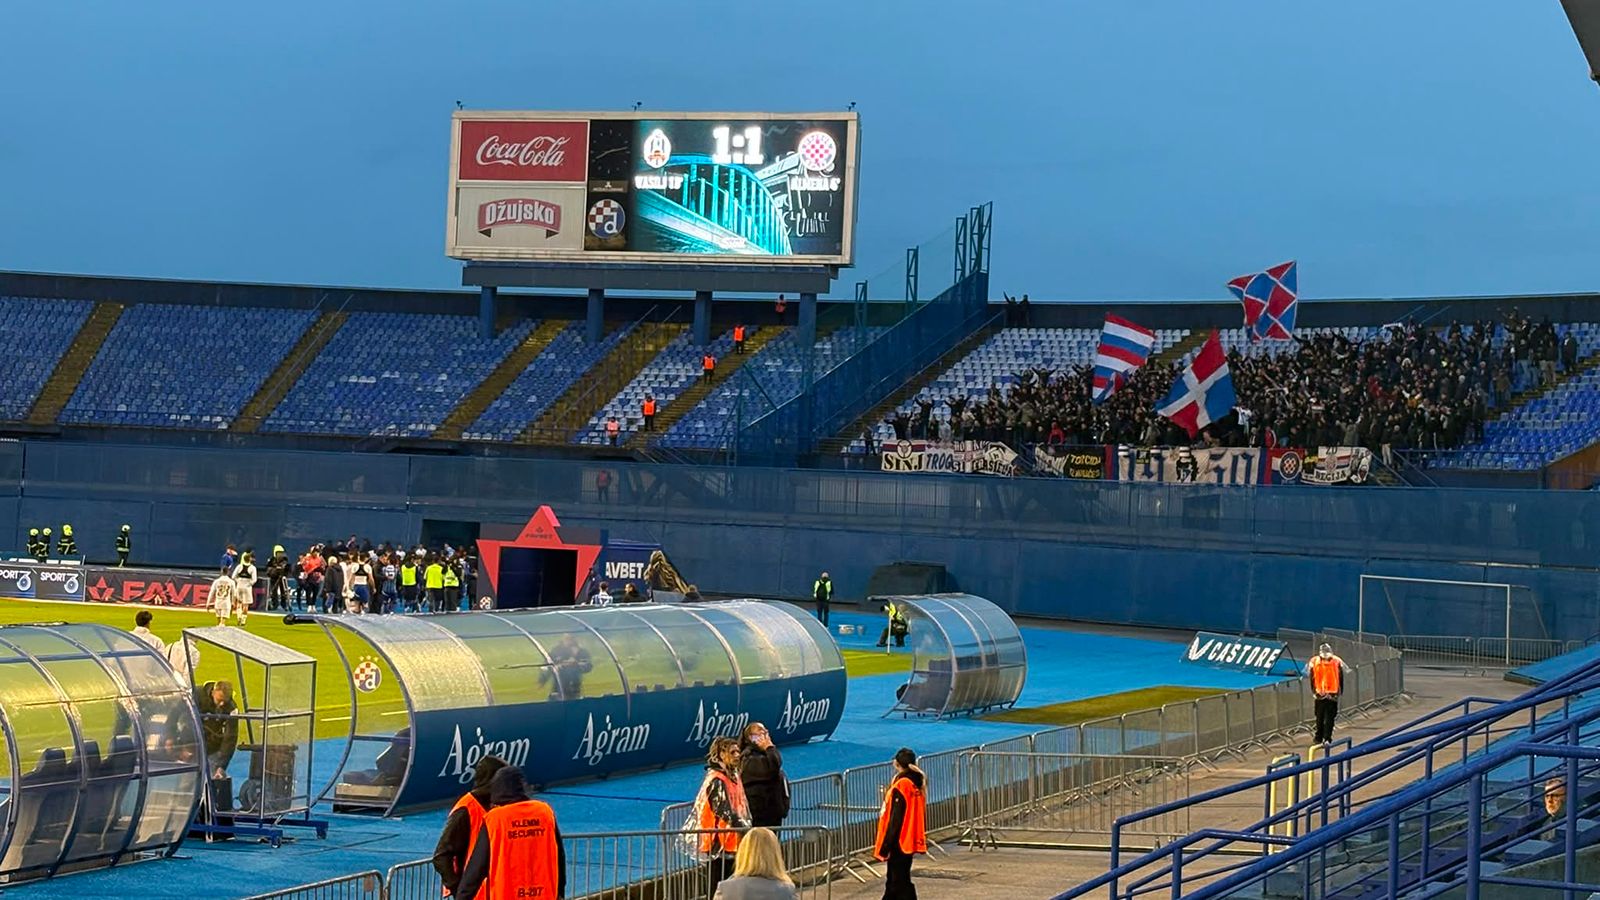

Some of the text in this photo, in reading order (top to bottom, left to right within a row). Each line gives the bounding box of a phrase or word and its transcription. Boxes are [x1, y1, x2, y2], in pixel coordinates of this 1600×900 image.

[476, 135, 570, 167] Coca-Cola
[712, 125, 764, 164] 1:1
[485, 200, 555, 224] Ožujsko
[0, 569, 19, 579] PORT
[122, 580, 215, 605] FAVE
[1208, 641, 1280, 669] CASTORE
[776, 690, 830, 734] Agram
[572, 712, 650, 766] Agram
[507, 828, 546, 840] SECURITY
